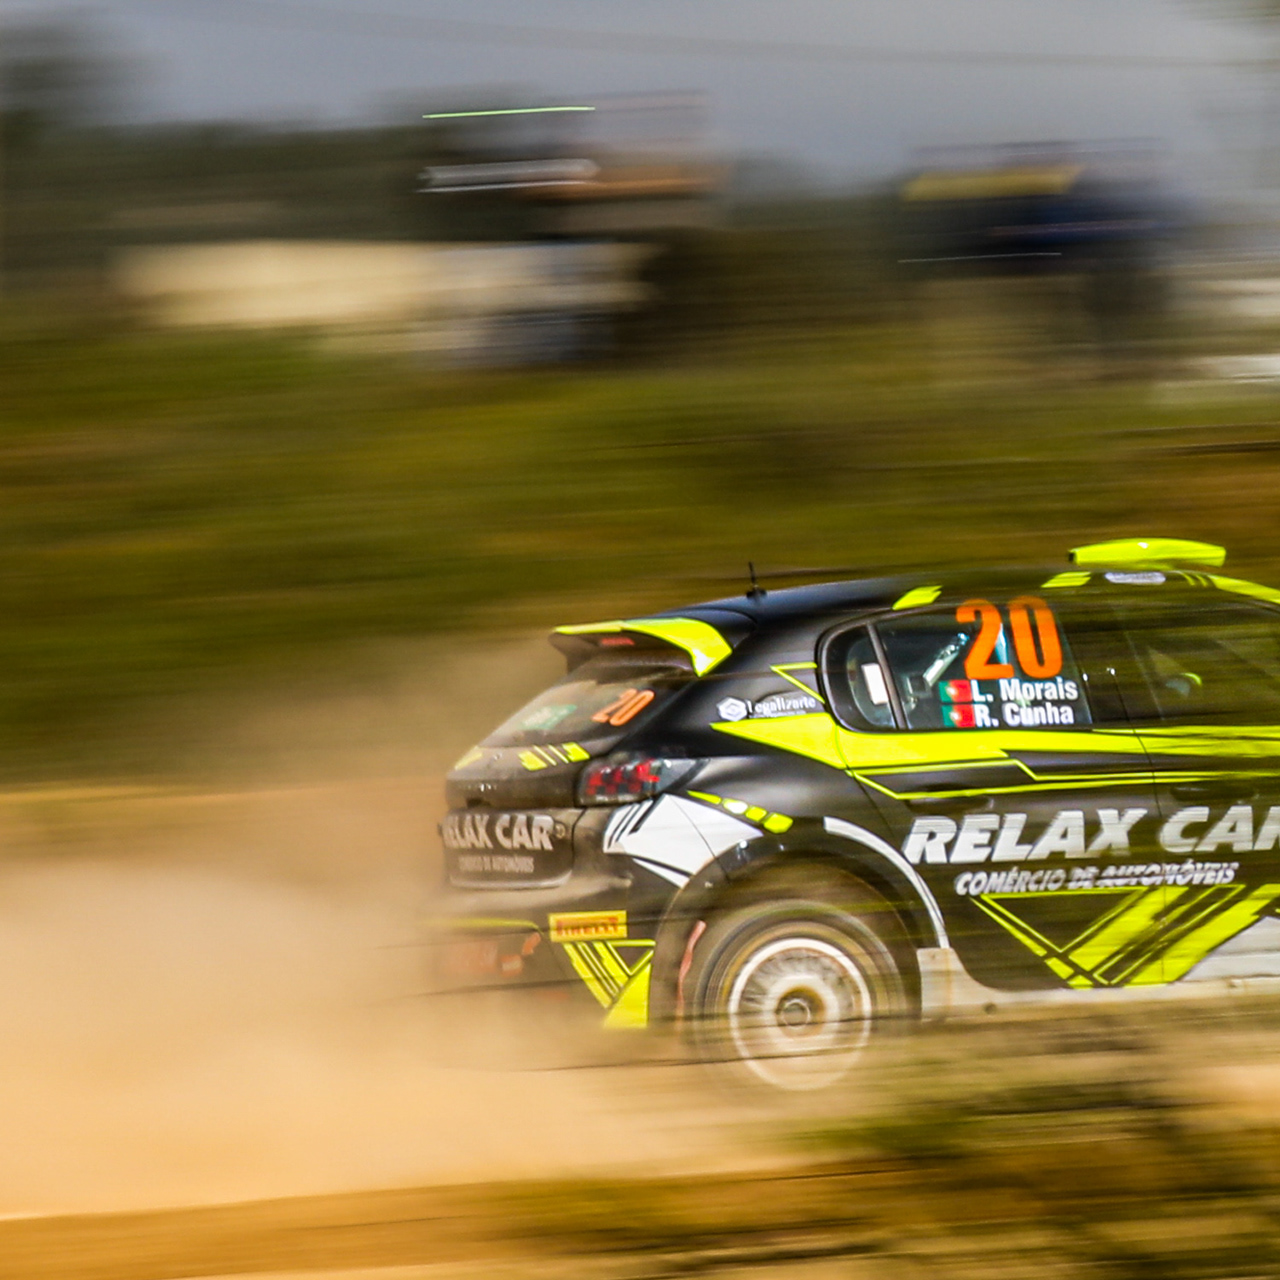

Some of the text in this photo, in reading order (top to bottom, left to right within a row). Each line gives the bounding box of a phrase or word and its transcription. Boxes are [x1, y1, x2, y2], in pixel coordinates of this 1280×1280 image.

[956, 595, 1063, 680] 20
[591, 688, 655, 726] 20
[970, 676, 1079, 702] L. Morais
[974, 702, 1075, 728] R. Cunha
[494, 814, 555, 852] CAR
[902, 807, 1149, 865] RELAX
[954, 865, 1068, 898] COMÉRCIO
